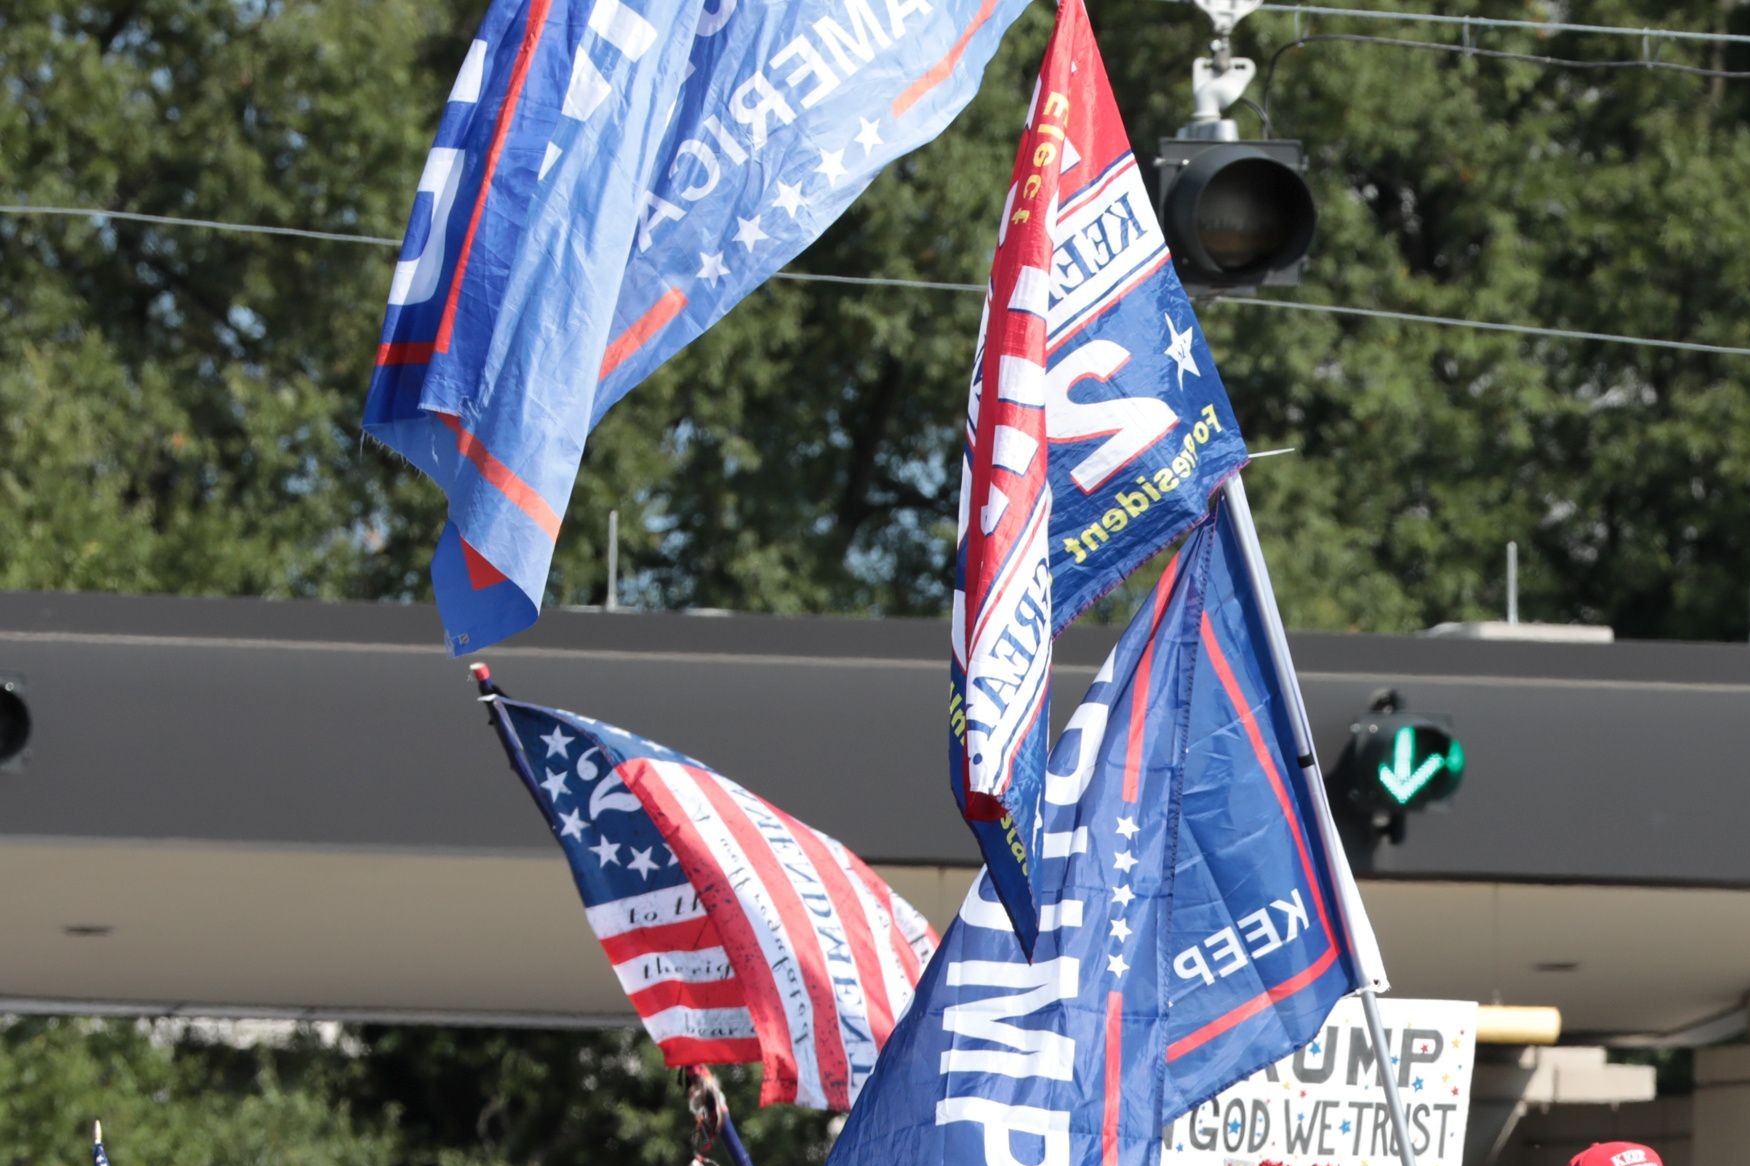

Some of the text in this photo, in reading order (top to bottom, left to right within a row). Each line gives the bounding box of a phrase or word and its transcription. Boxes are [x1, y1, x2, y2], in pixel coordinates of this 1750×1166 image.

[1189, 1097, 1270, 1153] GOD
[1285, 1099, 1340, 1156] WE
[1349, 1101, 1457, 1159] TRUST
